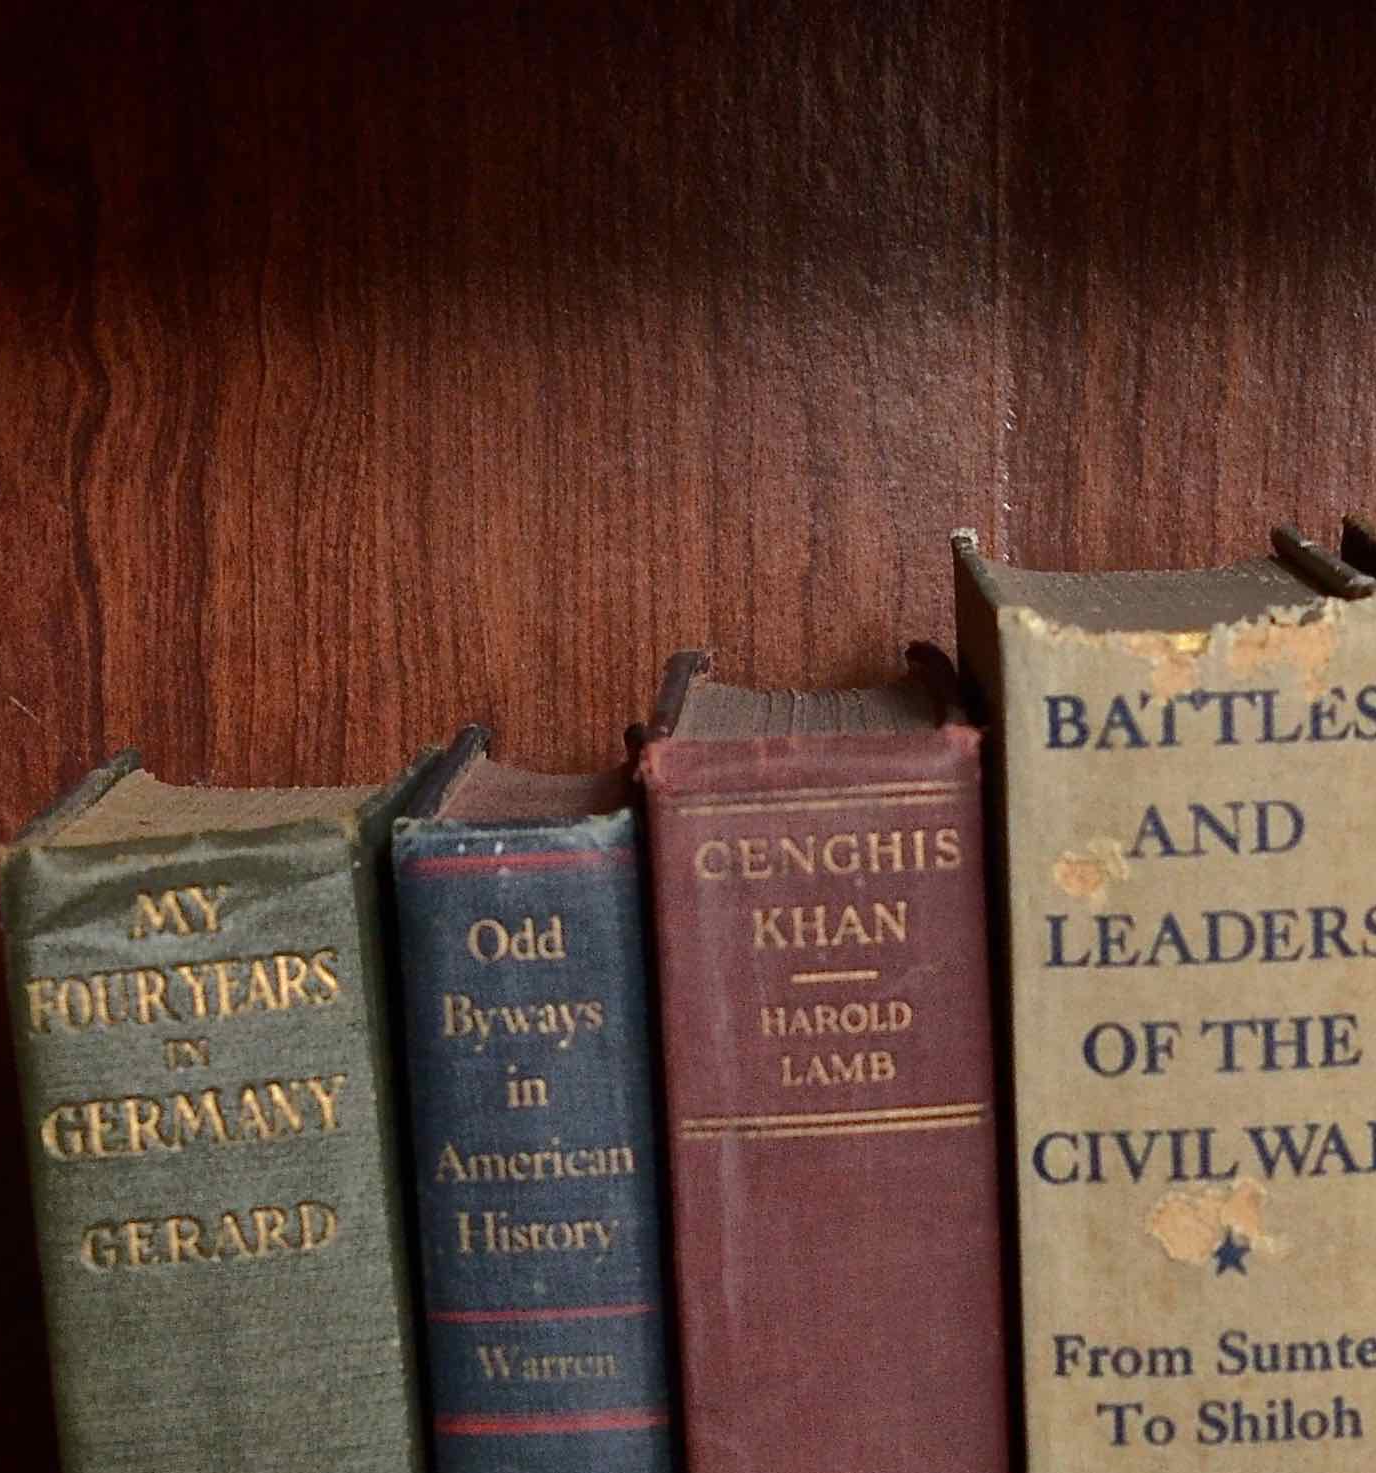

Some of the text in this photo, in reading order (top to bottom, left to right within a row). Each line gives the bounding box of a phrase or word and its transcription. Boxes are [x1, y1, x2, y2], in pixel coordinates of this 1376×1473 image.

[1127, 799, 1306, 859] AND
[128, 880, 228, 941] MY
[752, 899, 909, 950] KHAN
[466, 914, 568, 963] Odd
[23, 946, 343, 1035] FOUR YEARS
[440, 992, 606, 1054] Byways
[759, 1000, 914, 1038] HAROLD
[1082, 1012, 1363, 1078] OF THE
[162, 1038, 211, 1072] IN
[780, 1050, 898, 1087] LAMB
[505, 1064, 549, 1109] in
[39, 1072, 348, 1163] GERMANY
[433, 1135, 636, 1184] American
[1031, 1126, 1240, 1186] CIVIL
[79, 1200, 340, 1274] GERARD
[456, 1208, 622, 1265] History
[477, 1343, 620, 1381] Warren
[1053, 1333, 1195, 1379] From
[1096, 1395, 1365, 1447] To Shiloh
